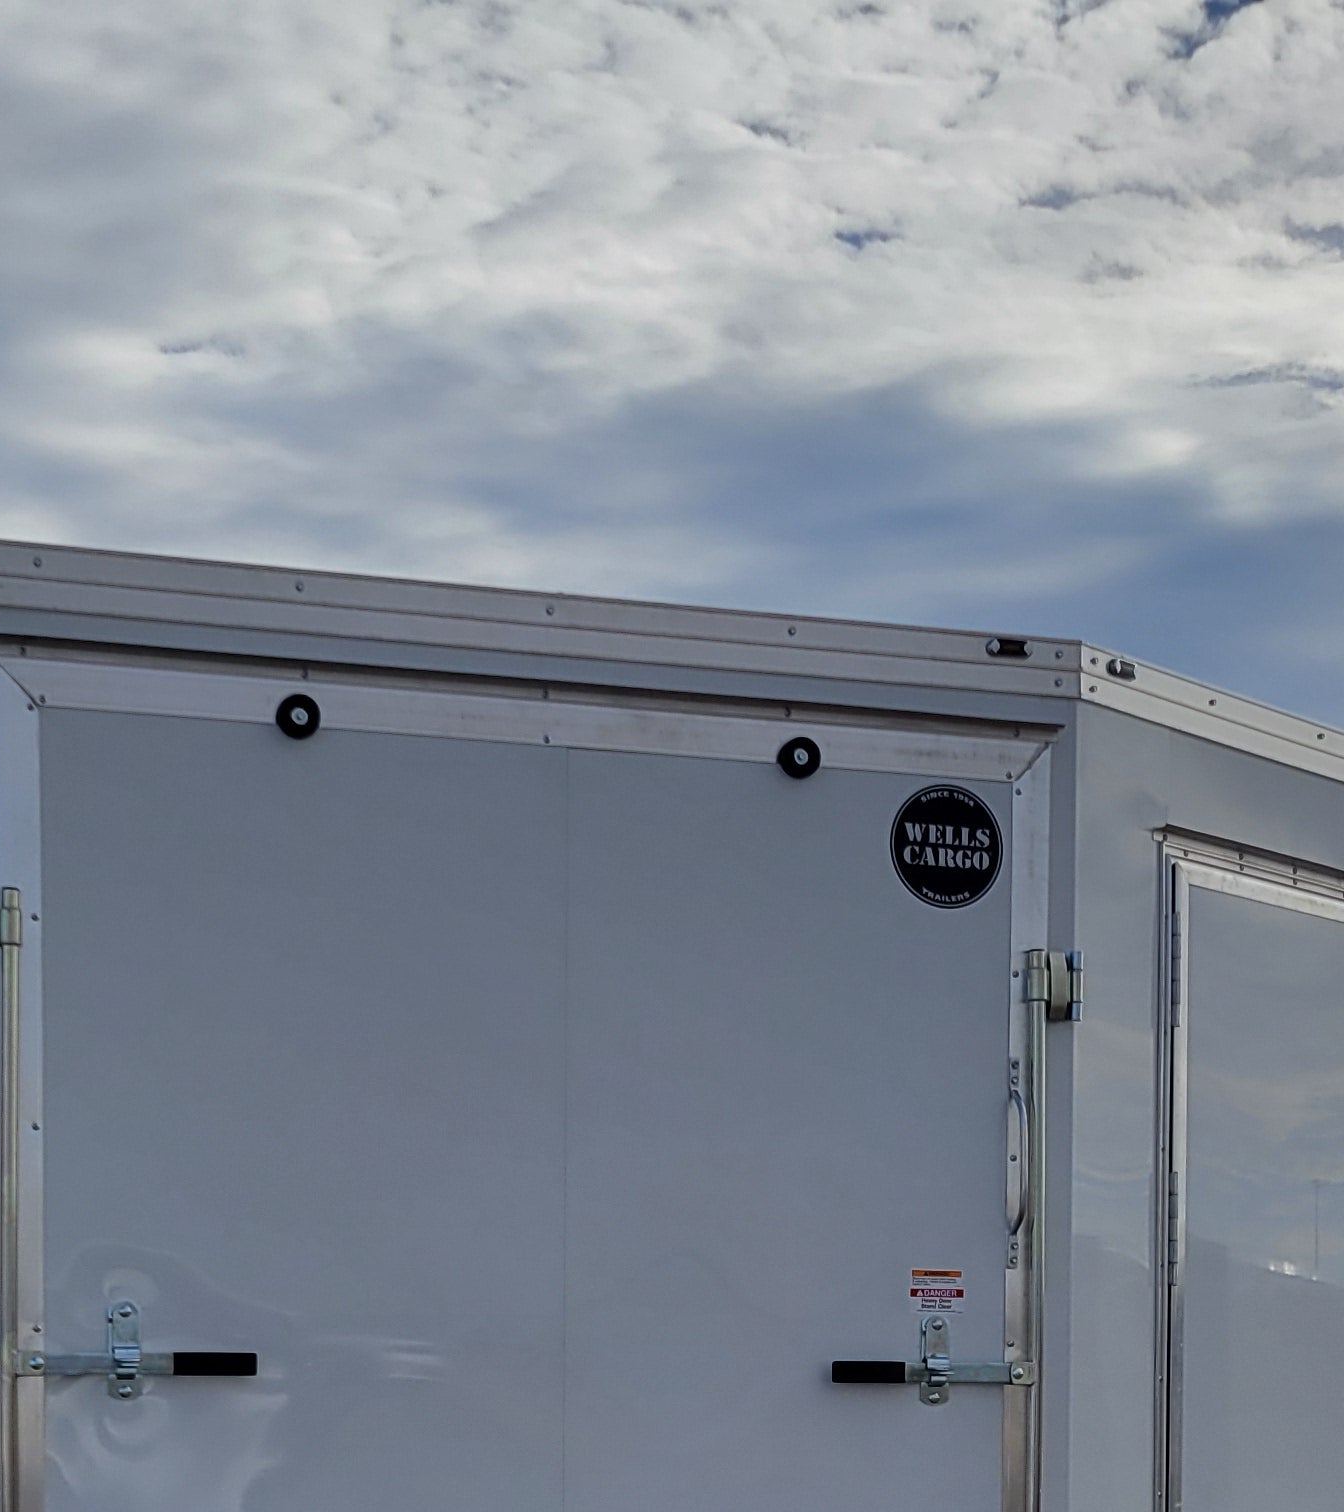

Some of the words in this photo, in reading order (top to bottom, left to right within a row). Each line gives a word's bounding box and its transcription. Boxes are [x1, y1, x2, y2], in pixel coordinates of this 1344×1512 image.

[921, 791, 950, 803] SINCE
[904, 822, 990, 848] WELLS
[903, 845, 990, 871] CARGO
[922, 886, 970, 902] TRAILERS
[924, 1289, 957, 1297] DANGER
